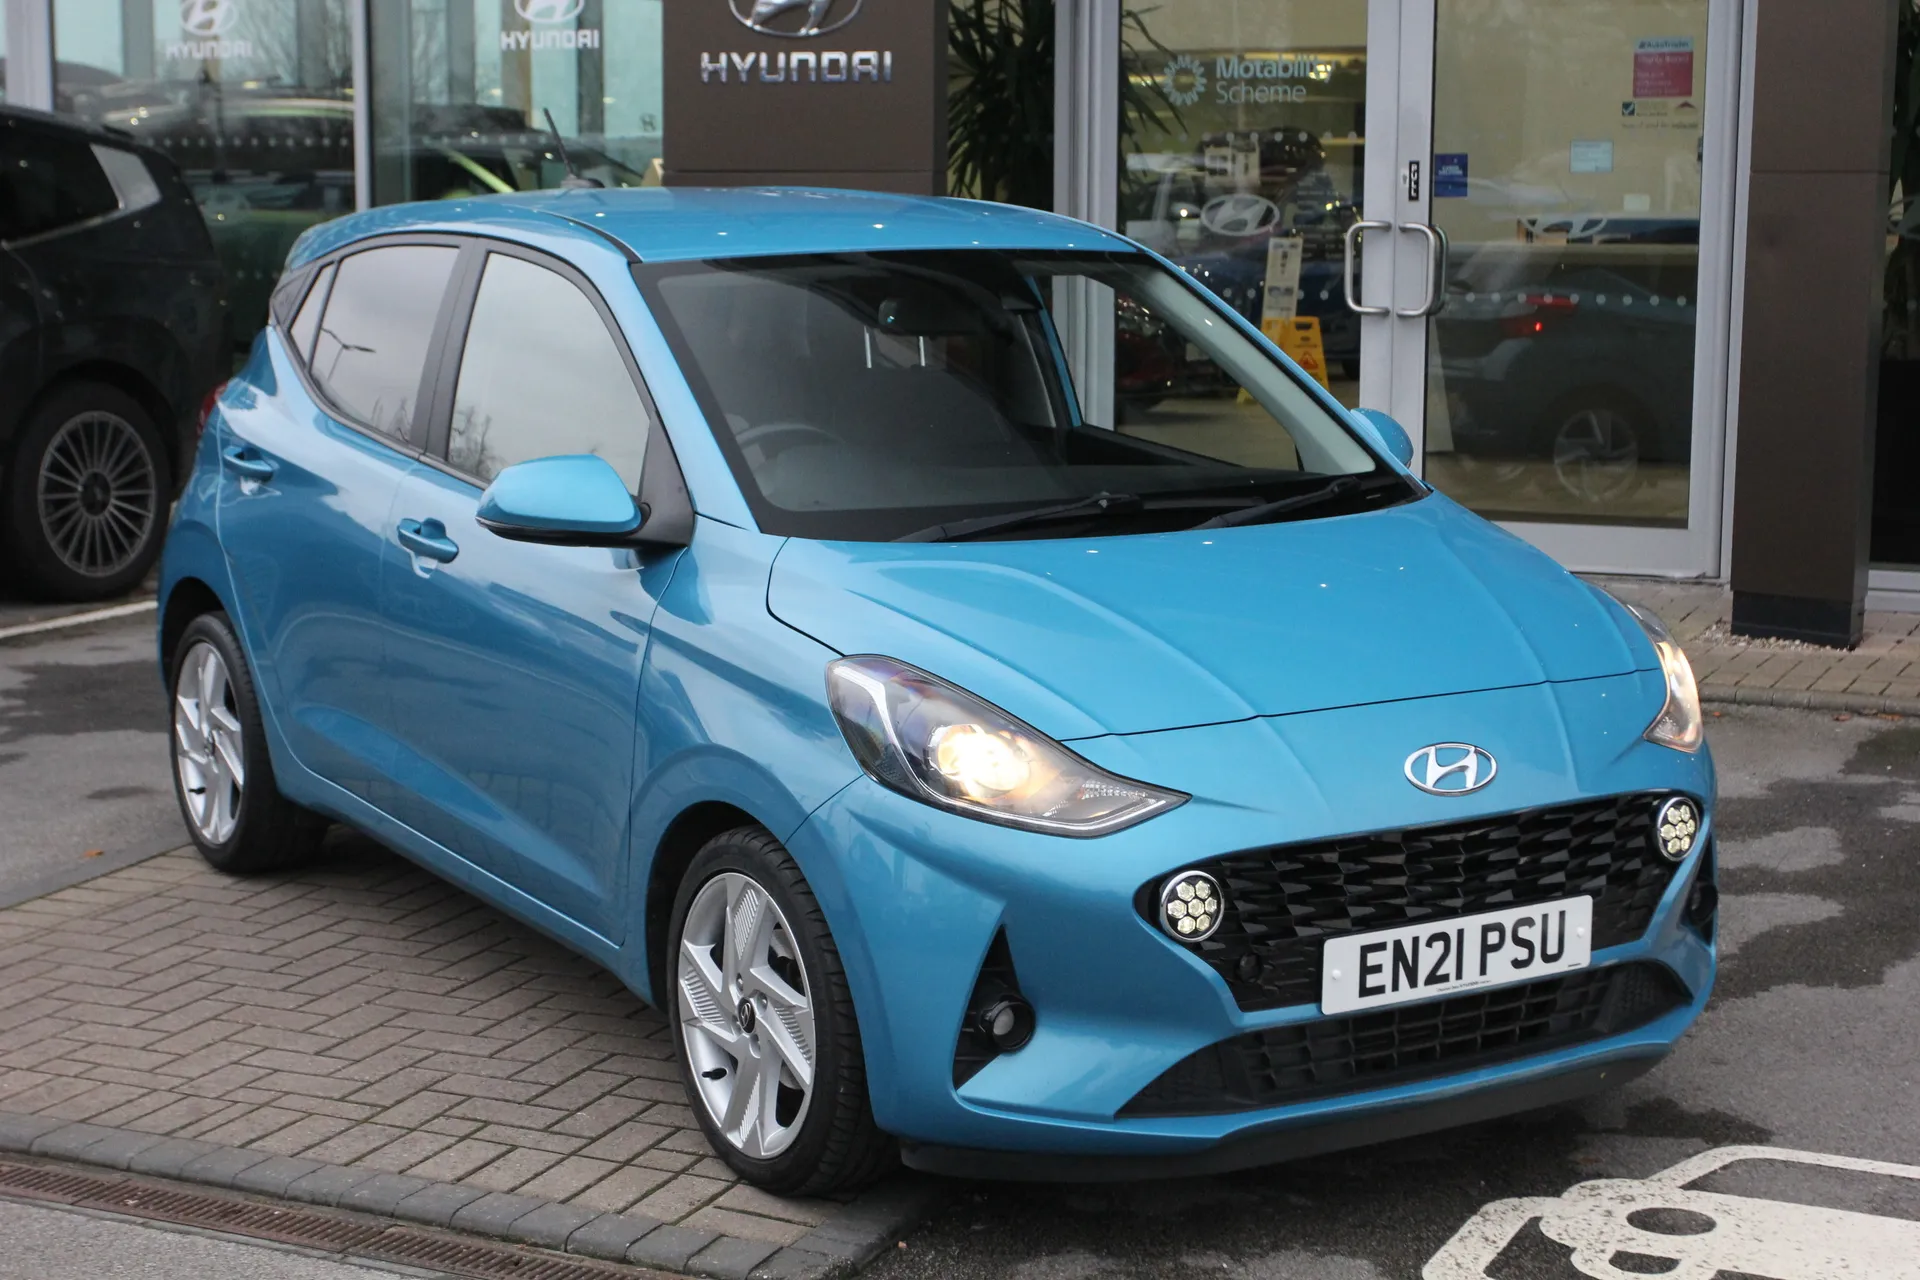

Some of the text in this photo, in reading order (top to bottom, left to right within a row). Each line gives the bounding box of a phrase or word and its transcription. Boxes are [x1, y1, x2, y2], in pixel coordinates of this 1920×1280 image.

[165, 40, 252, 60] HYUNDAI
[500, 29, 599, 51] HYUNDAI
[700, 51, 892, 83] HYUNDAI
[1216, 81, 1307, 104] Scheme
[1410, 162, 1418, 198] PULL
[1358, 910, 1566, 998] EN21 PSU
